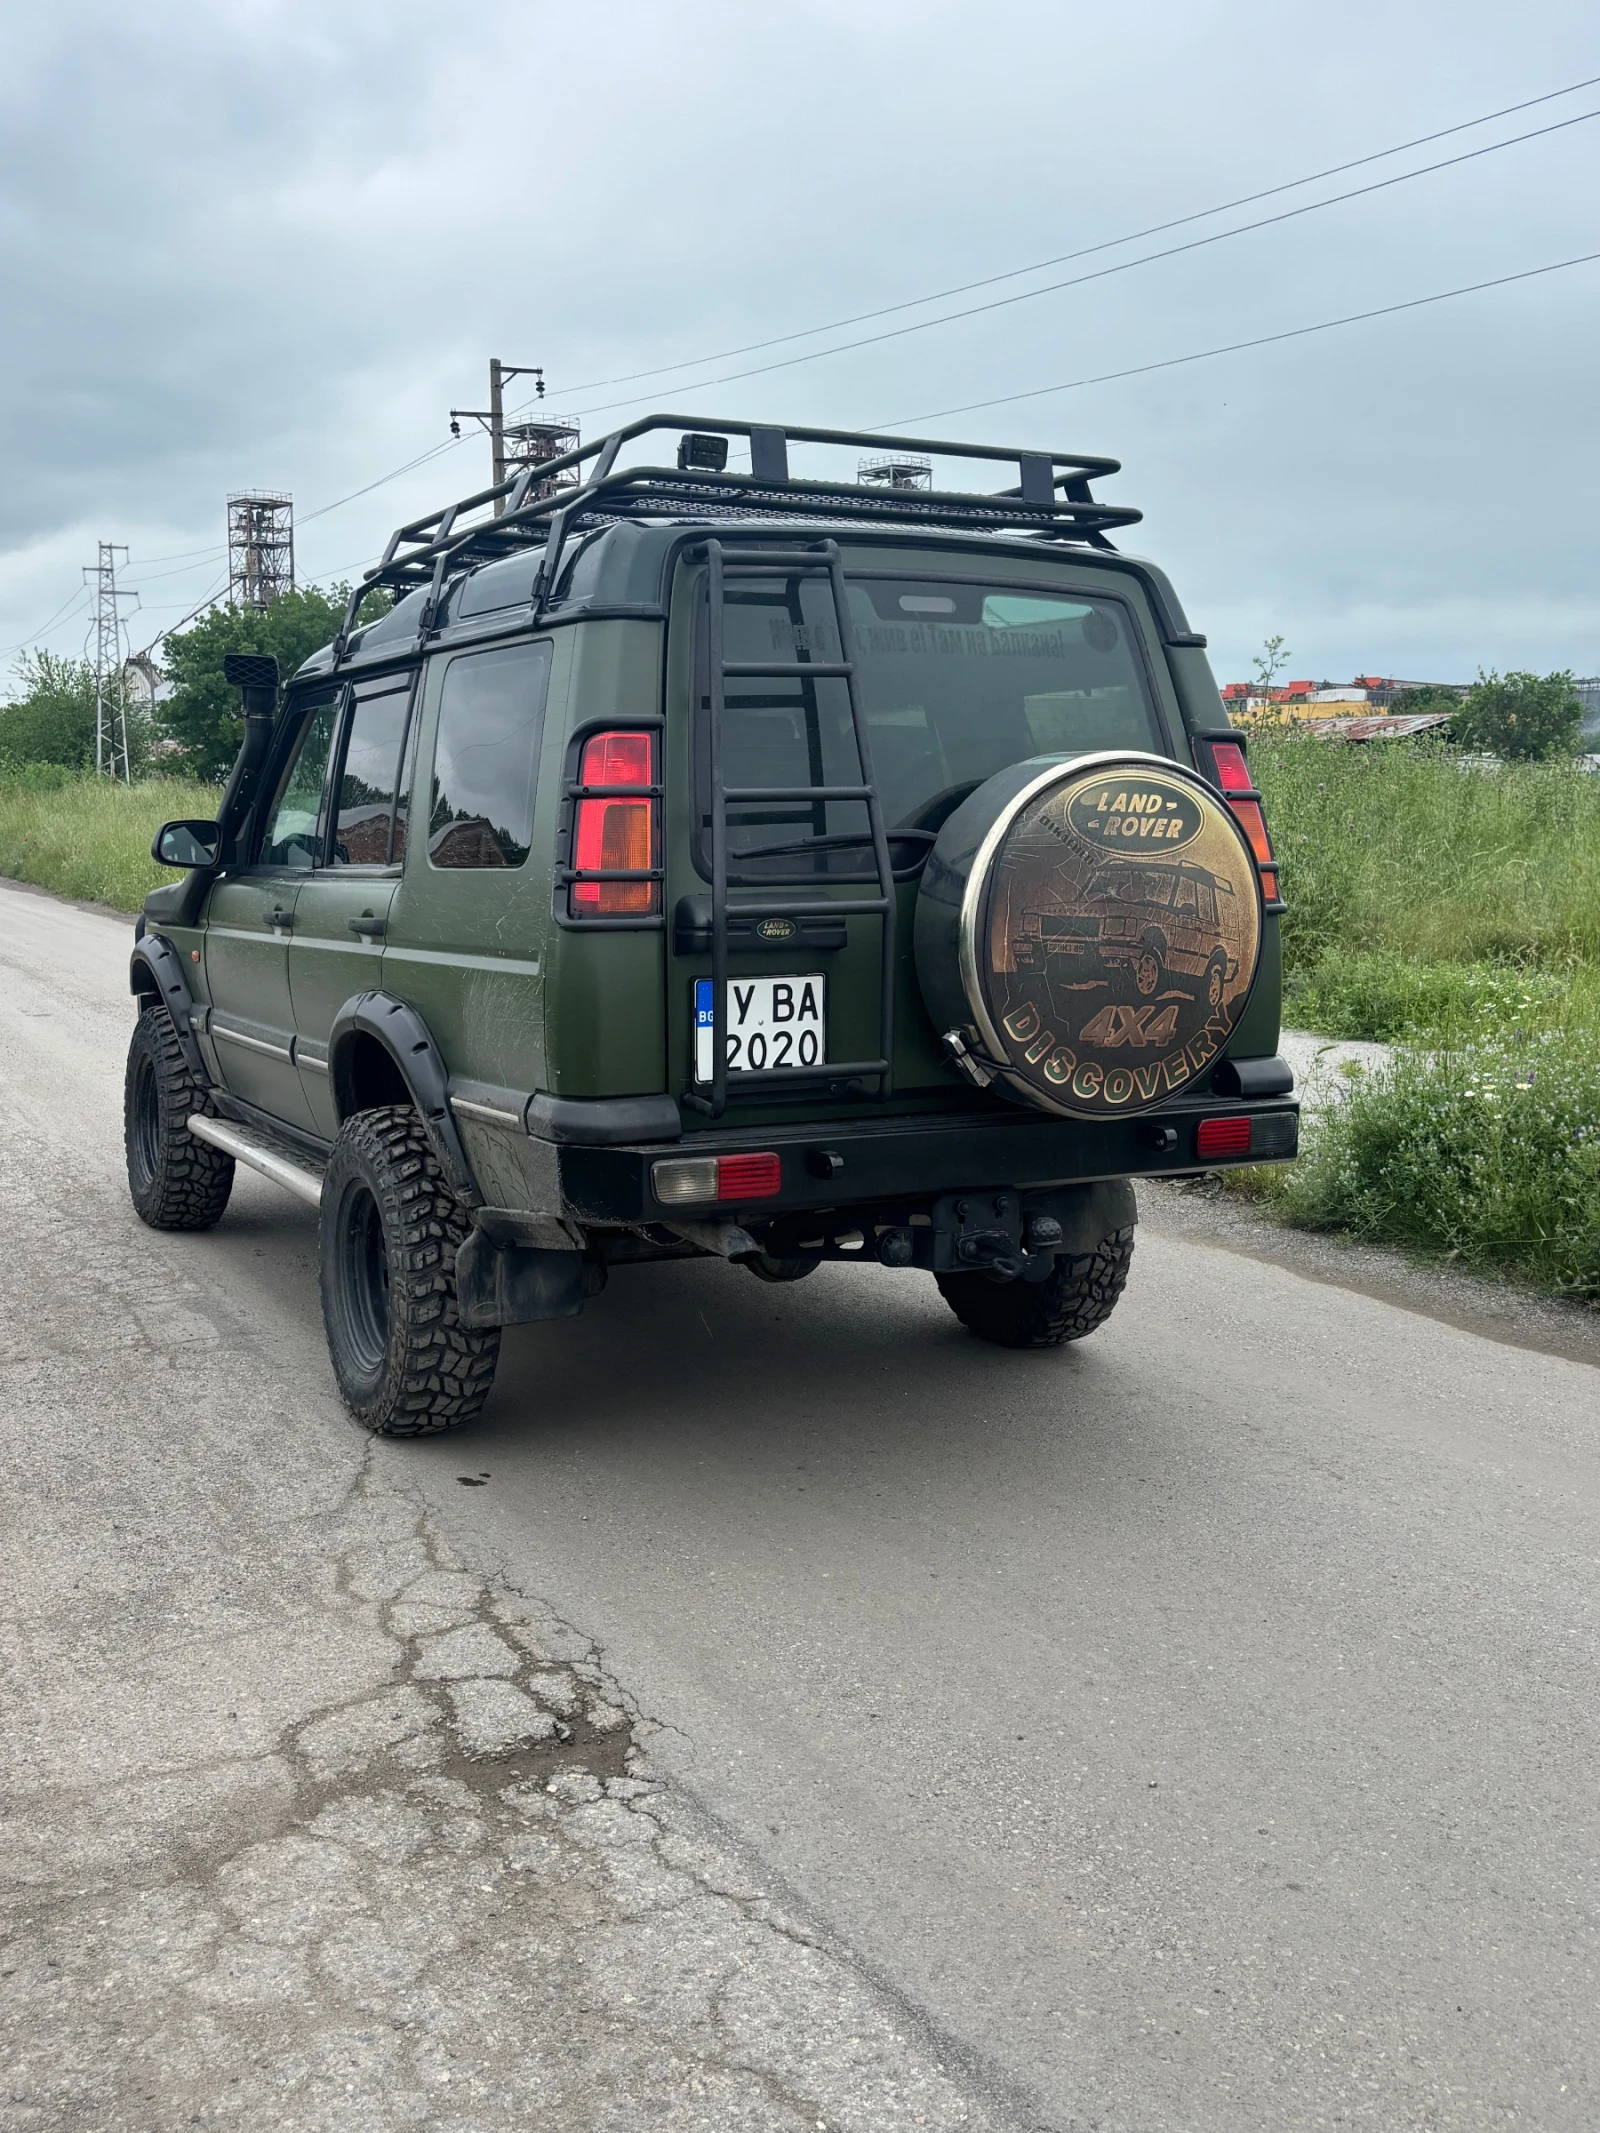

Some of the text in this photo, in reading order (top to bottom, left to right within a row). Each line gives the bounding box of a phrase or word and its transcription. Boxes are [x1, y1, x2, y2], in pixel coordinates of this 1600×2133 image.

[1097, 792, 1162, 813] LAND
[1103, 816, 1184, 838] ROVER
[699, 1010, 714, 1023] BG
[772, 982, 819, 1023] BA
[1079, 1005, 1178, 1048] 4X4
[726, 1029, 818, 1072] 2020
[1003, 1001, 1233, 1104] DISCOVERY
